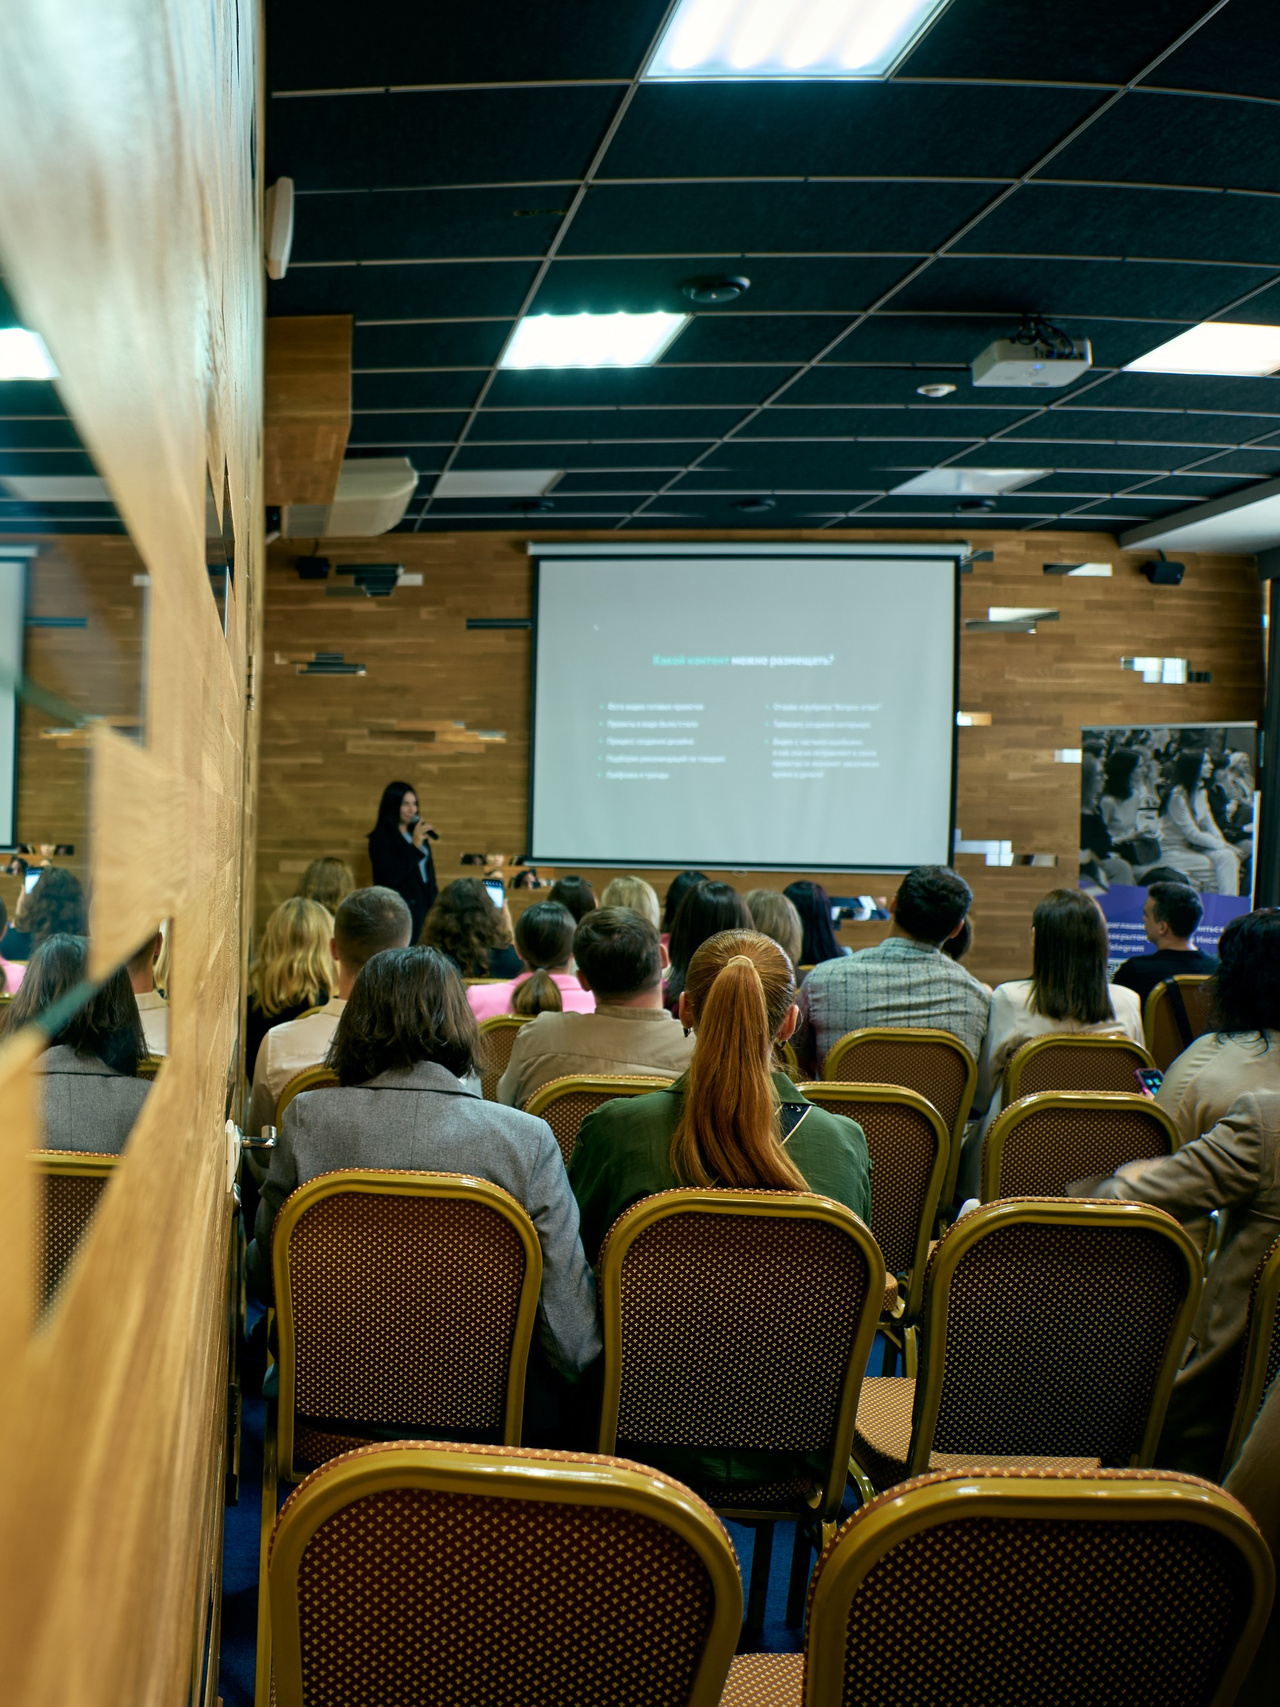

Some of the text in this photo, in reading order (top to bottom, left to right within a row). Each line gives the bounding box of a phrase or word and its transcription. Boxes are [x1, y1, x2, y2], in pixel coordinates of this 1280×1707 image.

[653, 653, 835, 669] Какой контент можно размещать?
